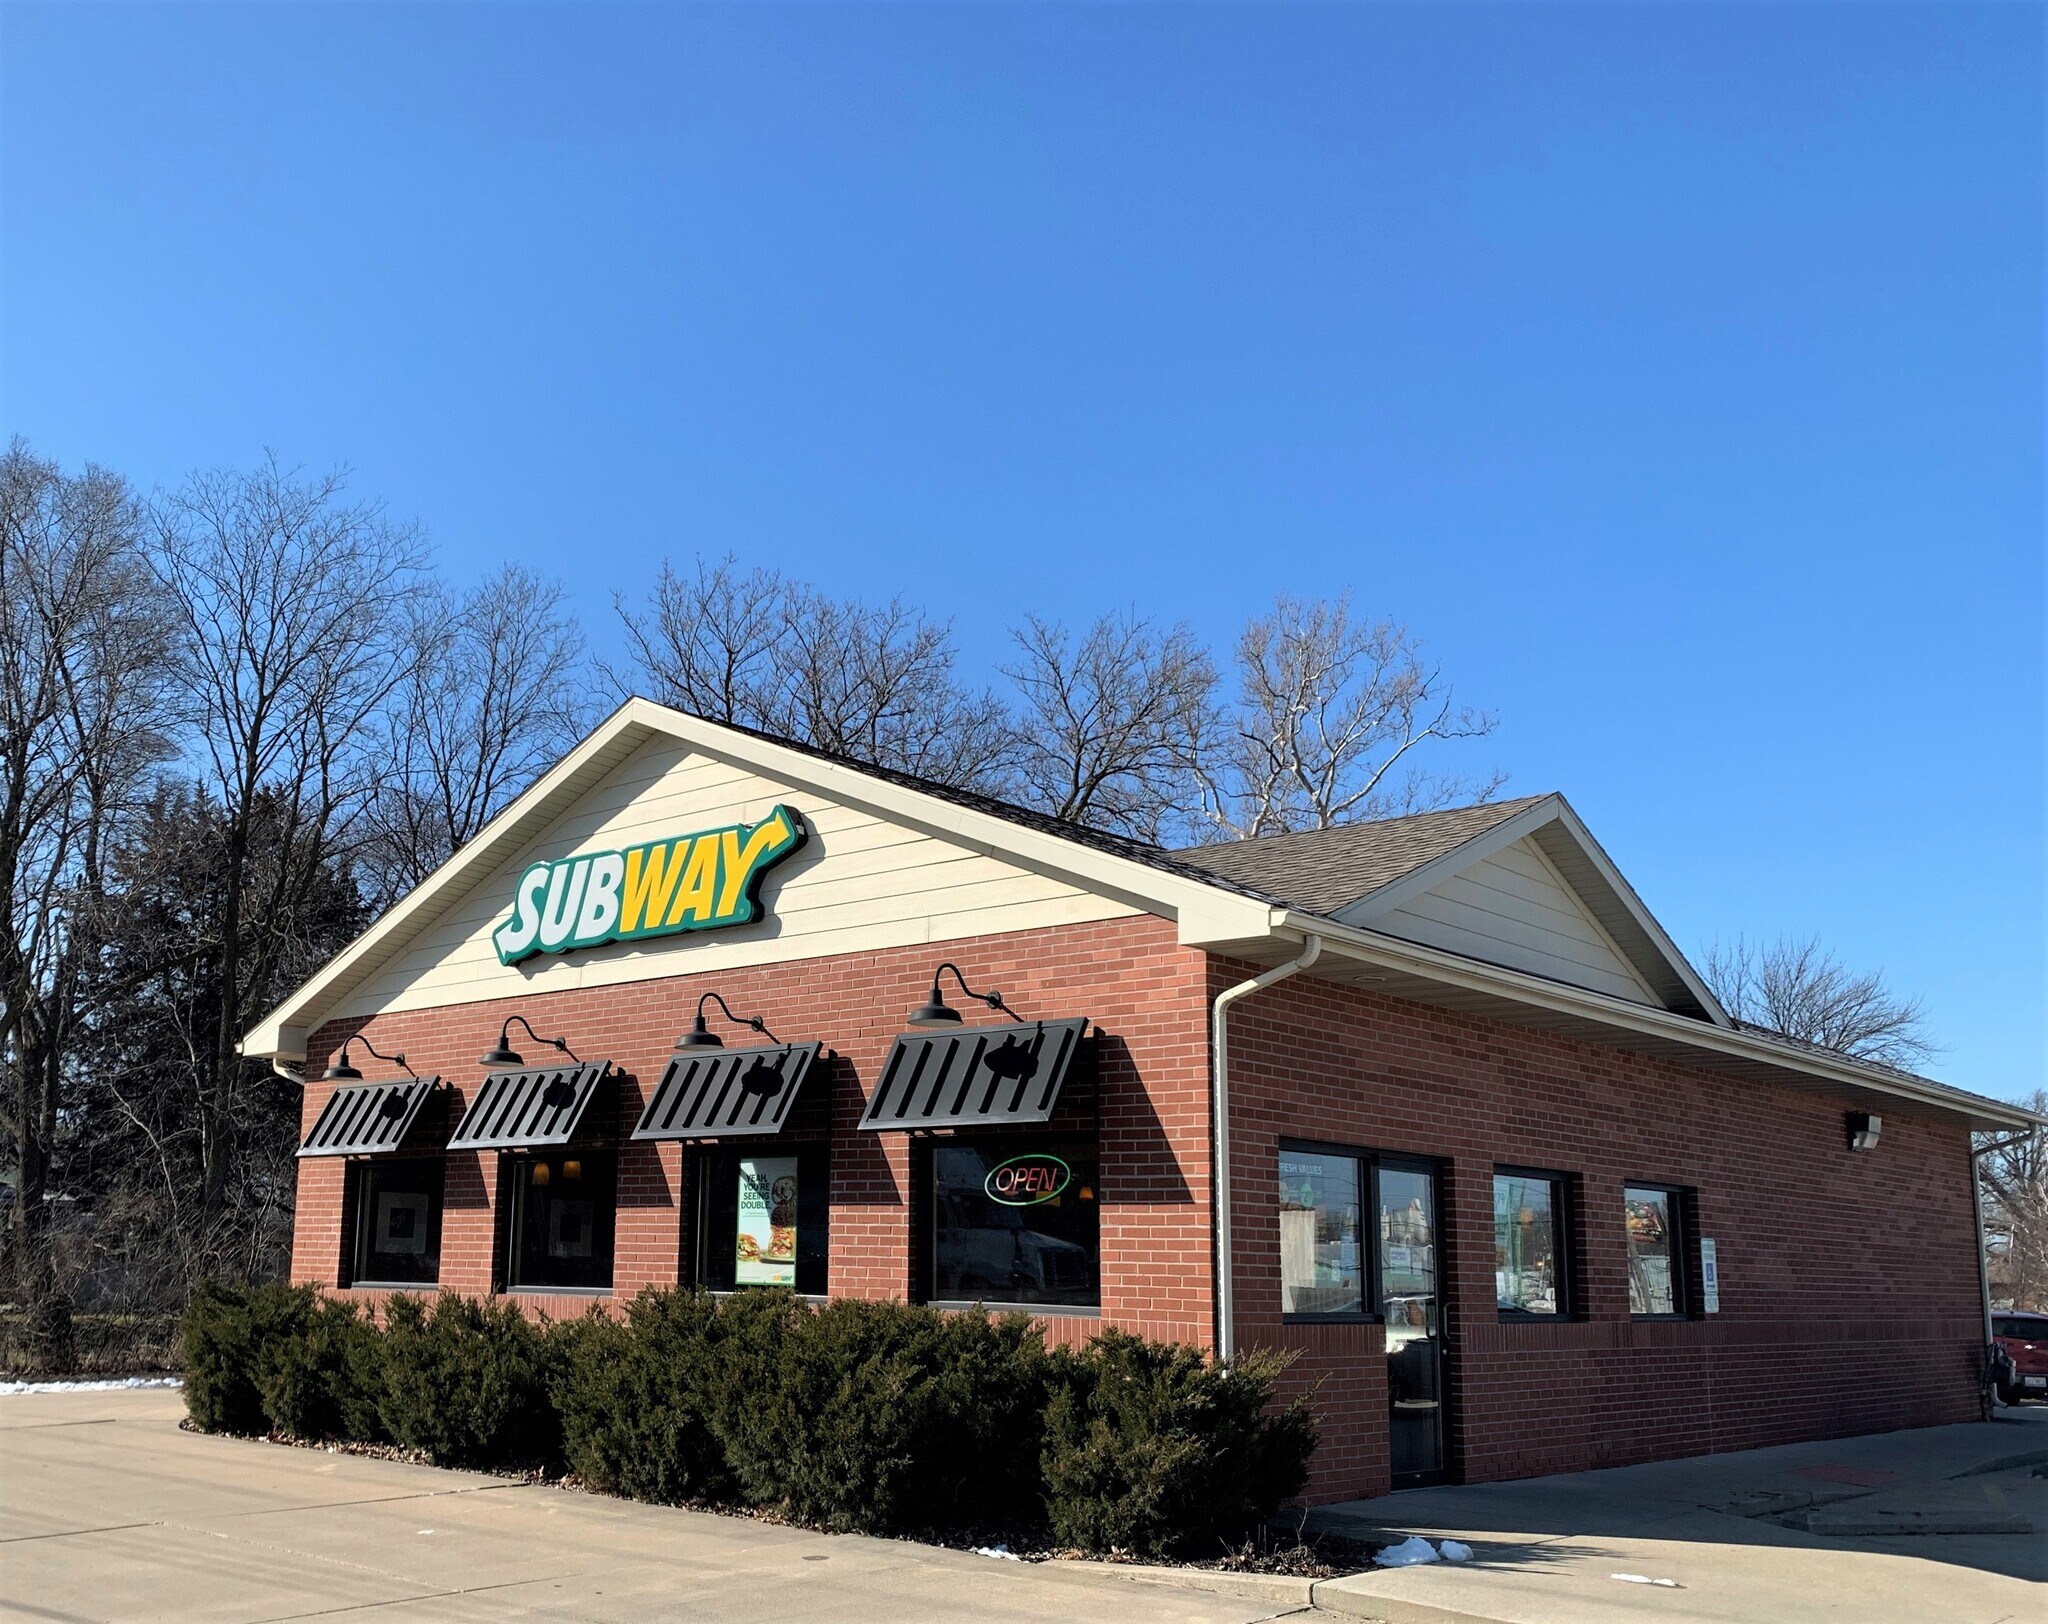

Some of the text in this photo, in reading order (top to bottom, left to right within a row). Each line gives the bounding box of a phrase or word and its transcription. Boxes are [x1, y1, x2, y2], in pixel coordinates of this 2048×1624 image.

[494, 811, 791, 957] SUBWAY
[1298, 1164, 1323, 1175] VALUES
[996, 1167, 1058, 1192] OPEN
[743, 1192, 770, 1200] SEEING
